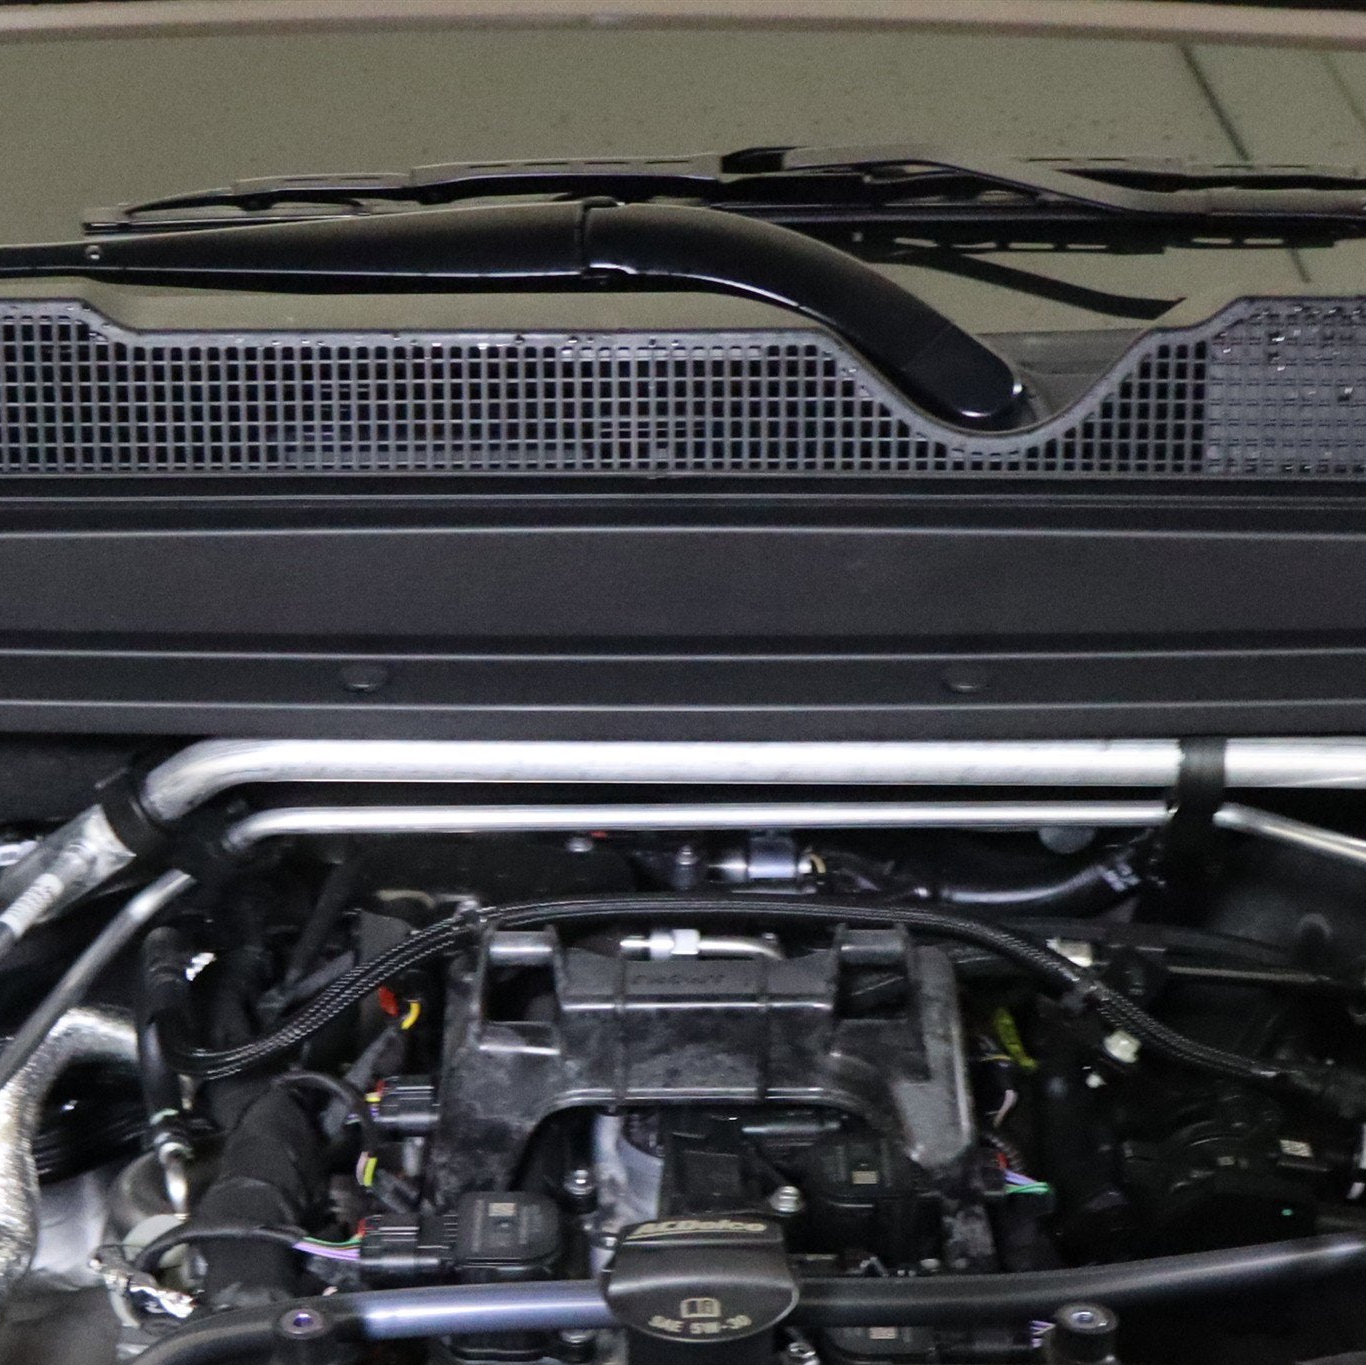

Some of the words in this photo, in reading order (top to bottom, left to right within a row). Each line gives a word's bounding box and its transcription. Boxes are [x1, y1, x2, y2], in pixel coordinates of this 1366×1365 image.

[628, 1220, 767, 1237] ACDelco
[648, 1315, 685, 1333] SAE
[690, 1315, 752, 1335] 5W-30
